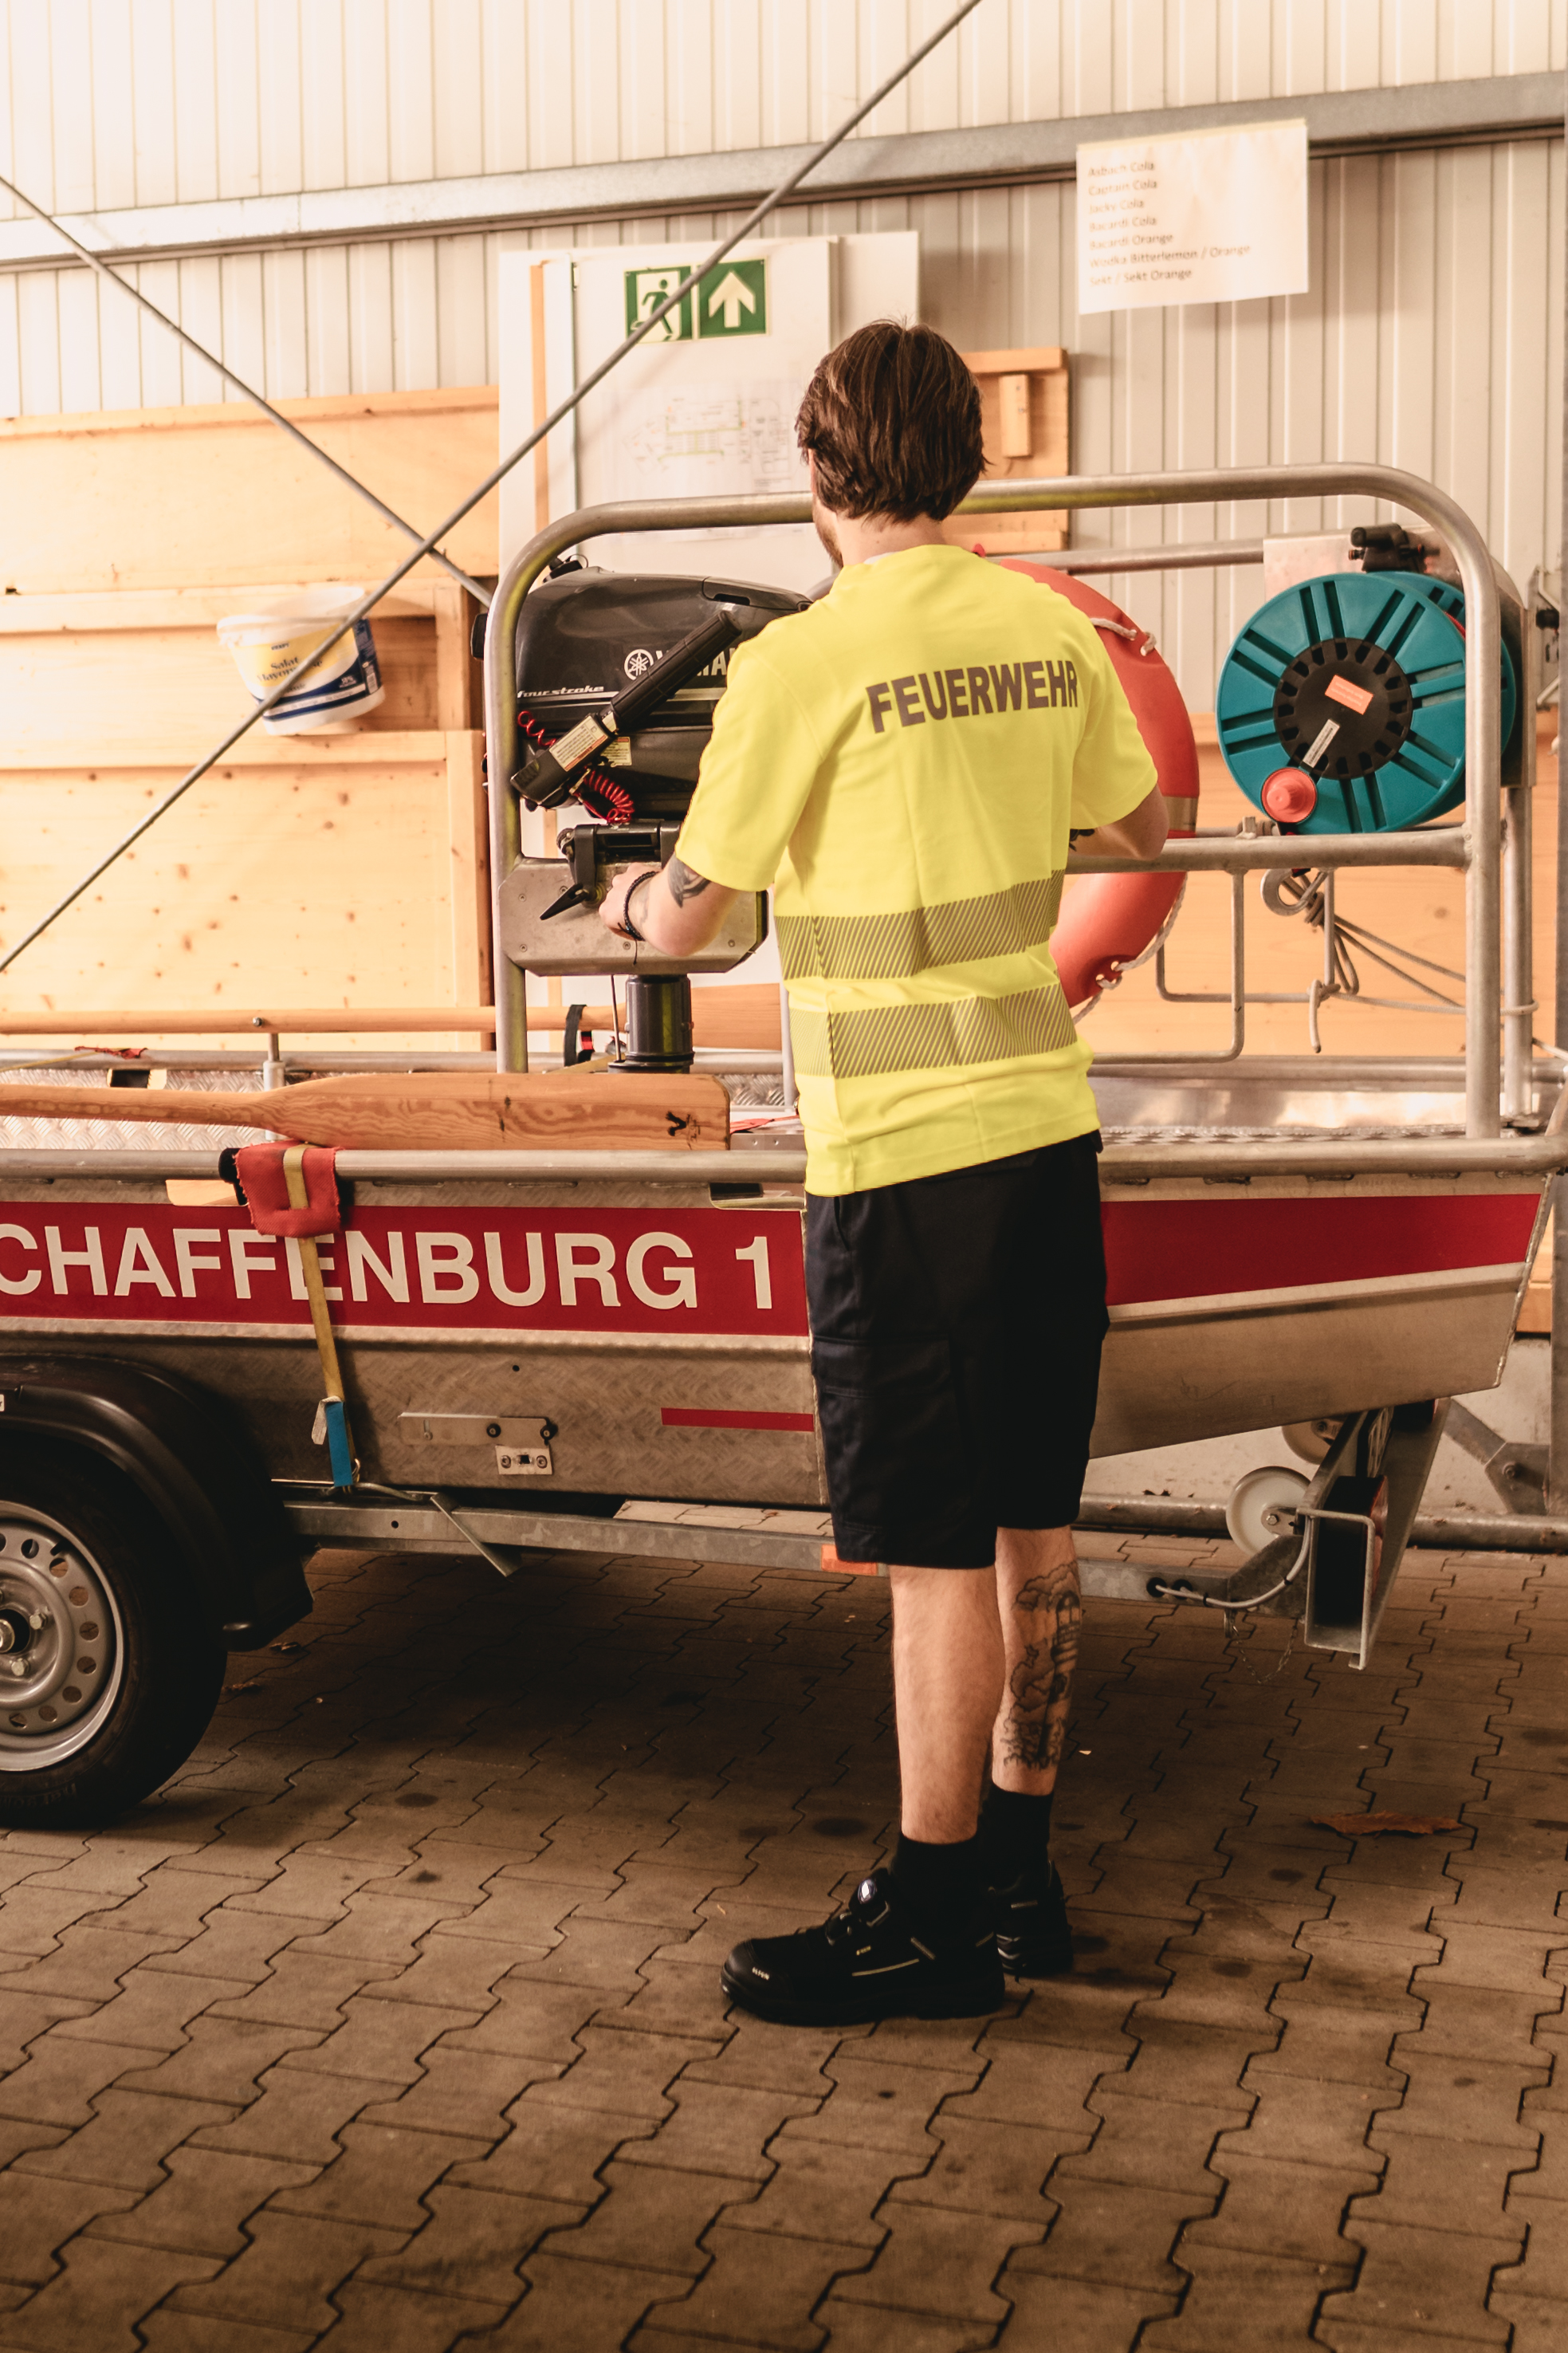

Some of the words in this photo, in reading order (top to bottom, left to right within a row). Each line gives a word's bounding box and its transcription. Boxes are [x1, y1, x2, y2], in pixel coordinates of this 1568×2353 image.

[1088, 164, 1126, 177] Asbach
[1130, 160, 1155, 172] Cola
[1088, 183, 1130, 196] Captain
[1132, 178, 1157, 190] Cola
[1089, 202, 1116, 214] Jacky
[1119, 198, 1144, 210] Cola
[1089, 217, 1129, 231] Bacardi
[1132, 214, 1157, 226] Cola
[1089, 235, 1129, 250] Bacardi
[1132, 234, 1173, 246] Orange
[1089, 254, 1127, 268] Wodka
[1130, 250, 1197, 264] Bitterlemon
[1210, 244, 1251, 258] Orange
[1089, 274, 1111, 286] Sekt
[1123, 270, 1147, 283] Sekt
[1150, 269, 1192, 281] Orange
[271, 656, 298, 670] Salat
[866, 660, 1078, 734] FEUERWEHR
[735, 1236, 773, 1310] 1
